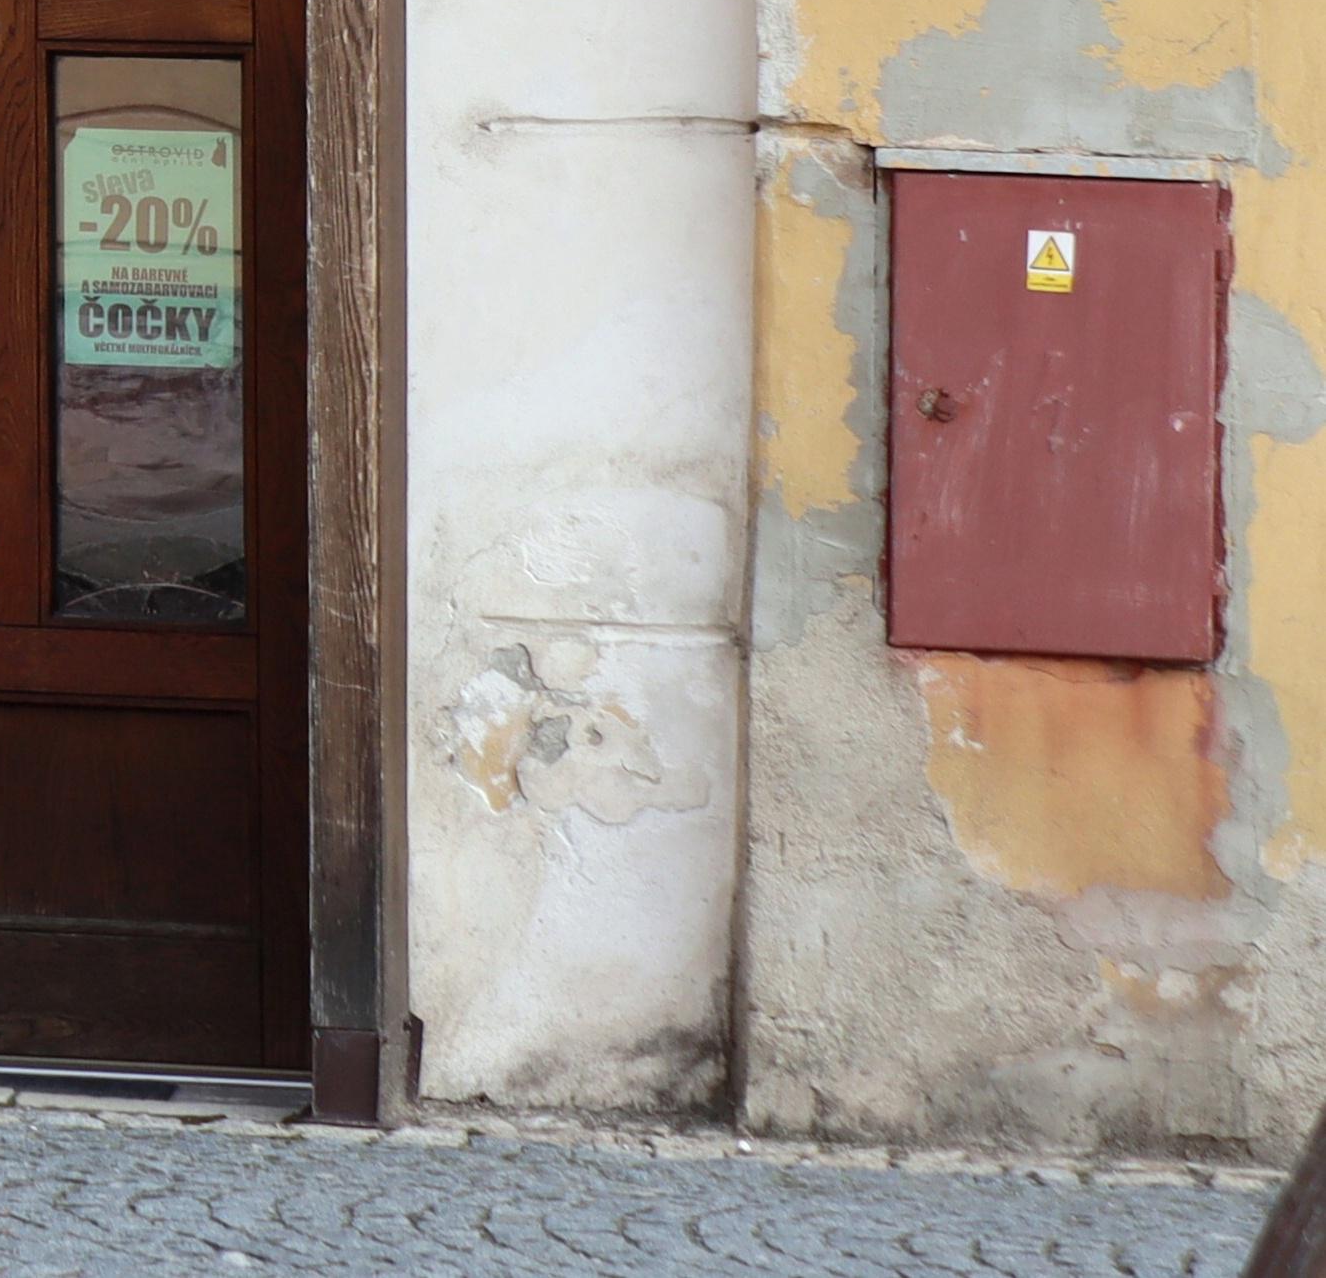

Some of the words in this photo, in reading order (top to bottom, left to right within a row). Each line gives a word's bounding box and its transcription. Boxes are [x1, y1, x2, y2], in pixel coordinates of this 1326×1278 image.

[112, 144, 205, 161] OSTROVID
[82, 169, 155, 203] sleva
[79, 194, 218, 256] -20%
[112, 266, 129, 280] NA
[132, 267, 188, 283] BAREVNÉ
[81, 280, 90, 294] A
[92, 280, 218, 299] SAMOZABARVOVACÍ
[78, 295, 217, 342] ČOČKY
